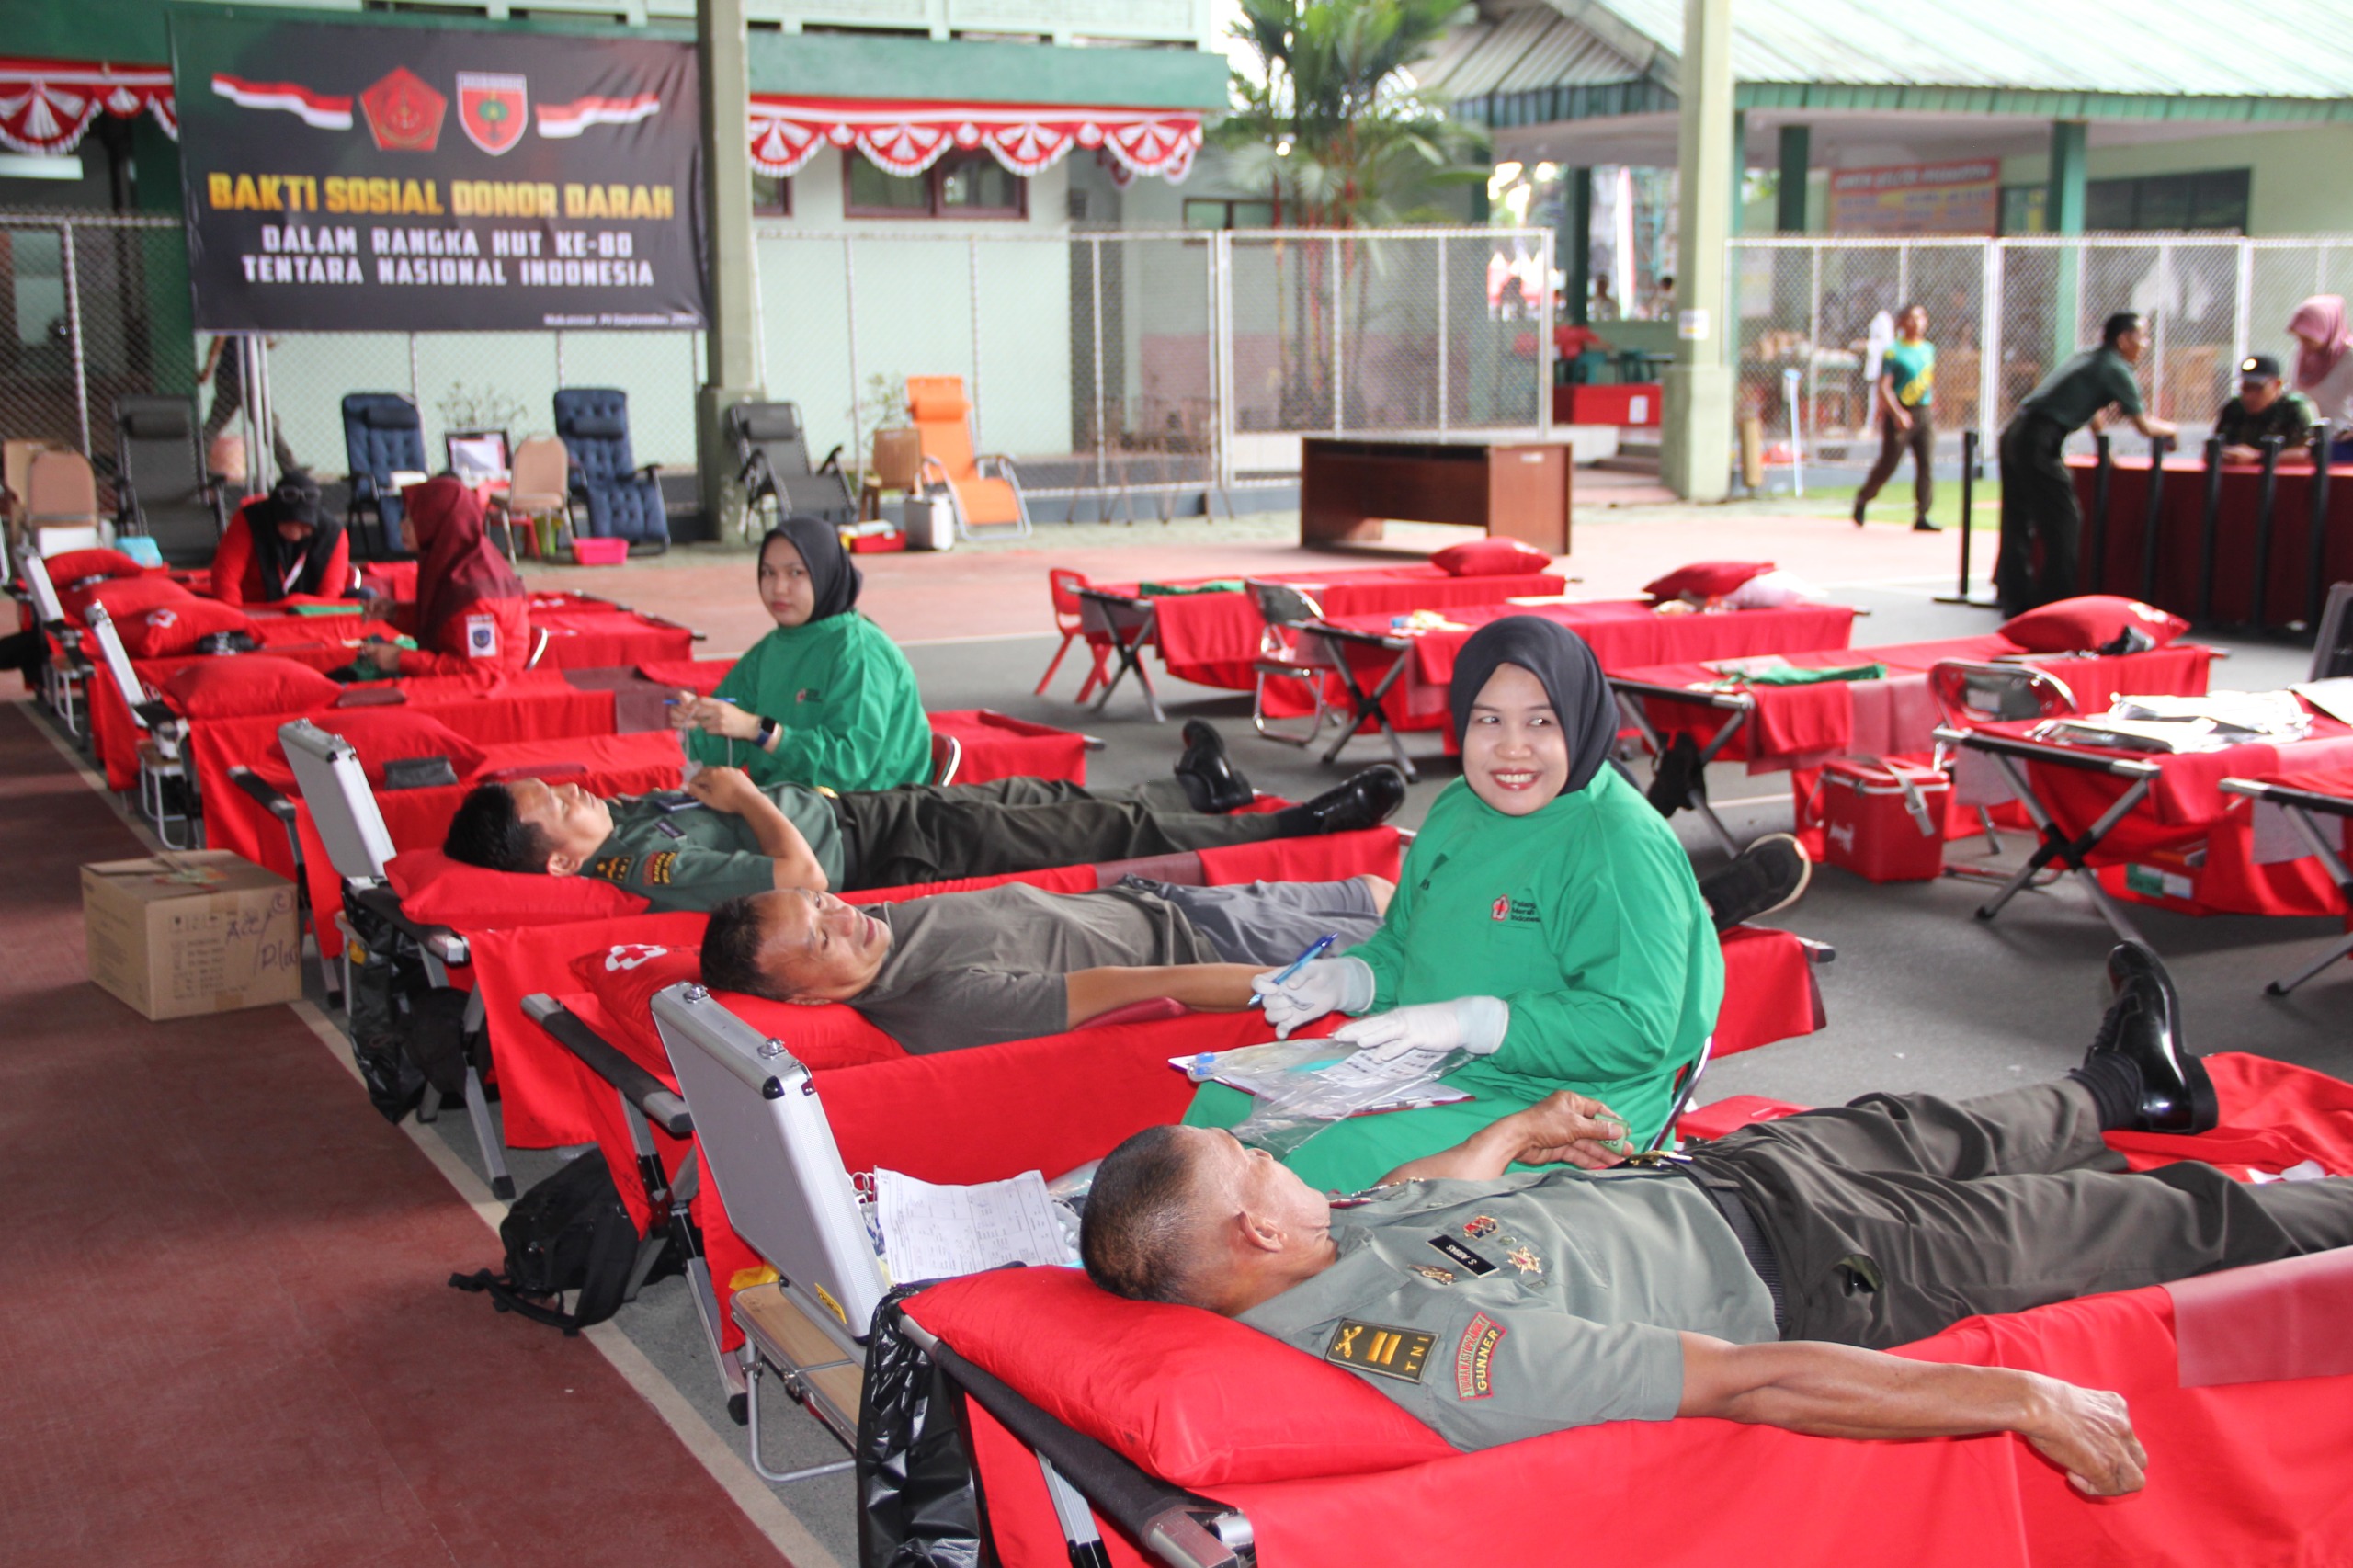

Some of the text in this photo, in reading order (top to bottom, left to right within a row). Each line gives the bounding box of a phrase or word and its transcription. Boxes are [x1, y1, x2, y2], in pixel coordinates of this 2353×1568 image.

[208, 172, 674, 220] BAKTI SOSIAL DONOR DARAH
[261, 224, 633, 258] DALAM RANGKA HUT KE-80
[241, 254, 654, 287] TENTARA NASIONAL INDONESIA
[1404, 1335, 1430, 1372] TNI
[1475, 1329, 1499, 1392] GUNNER
